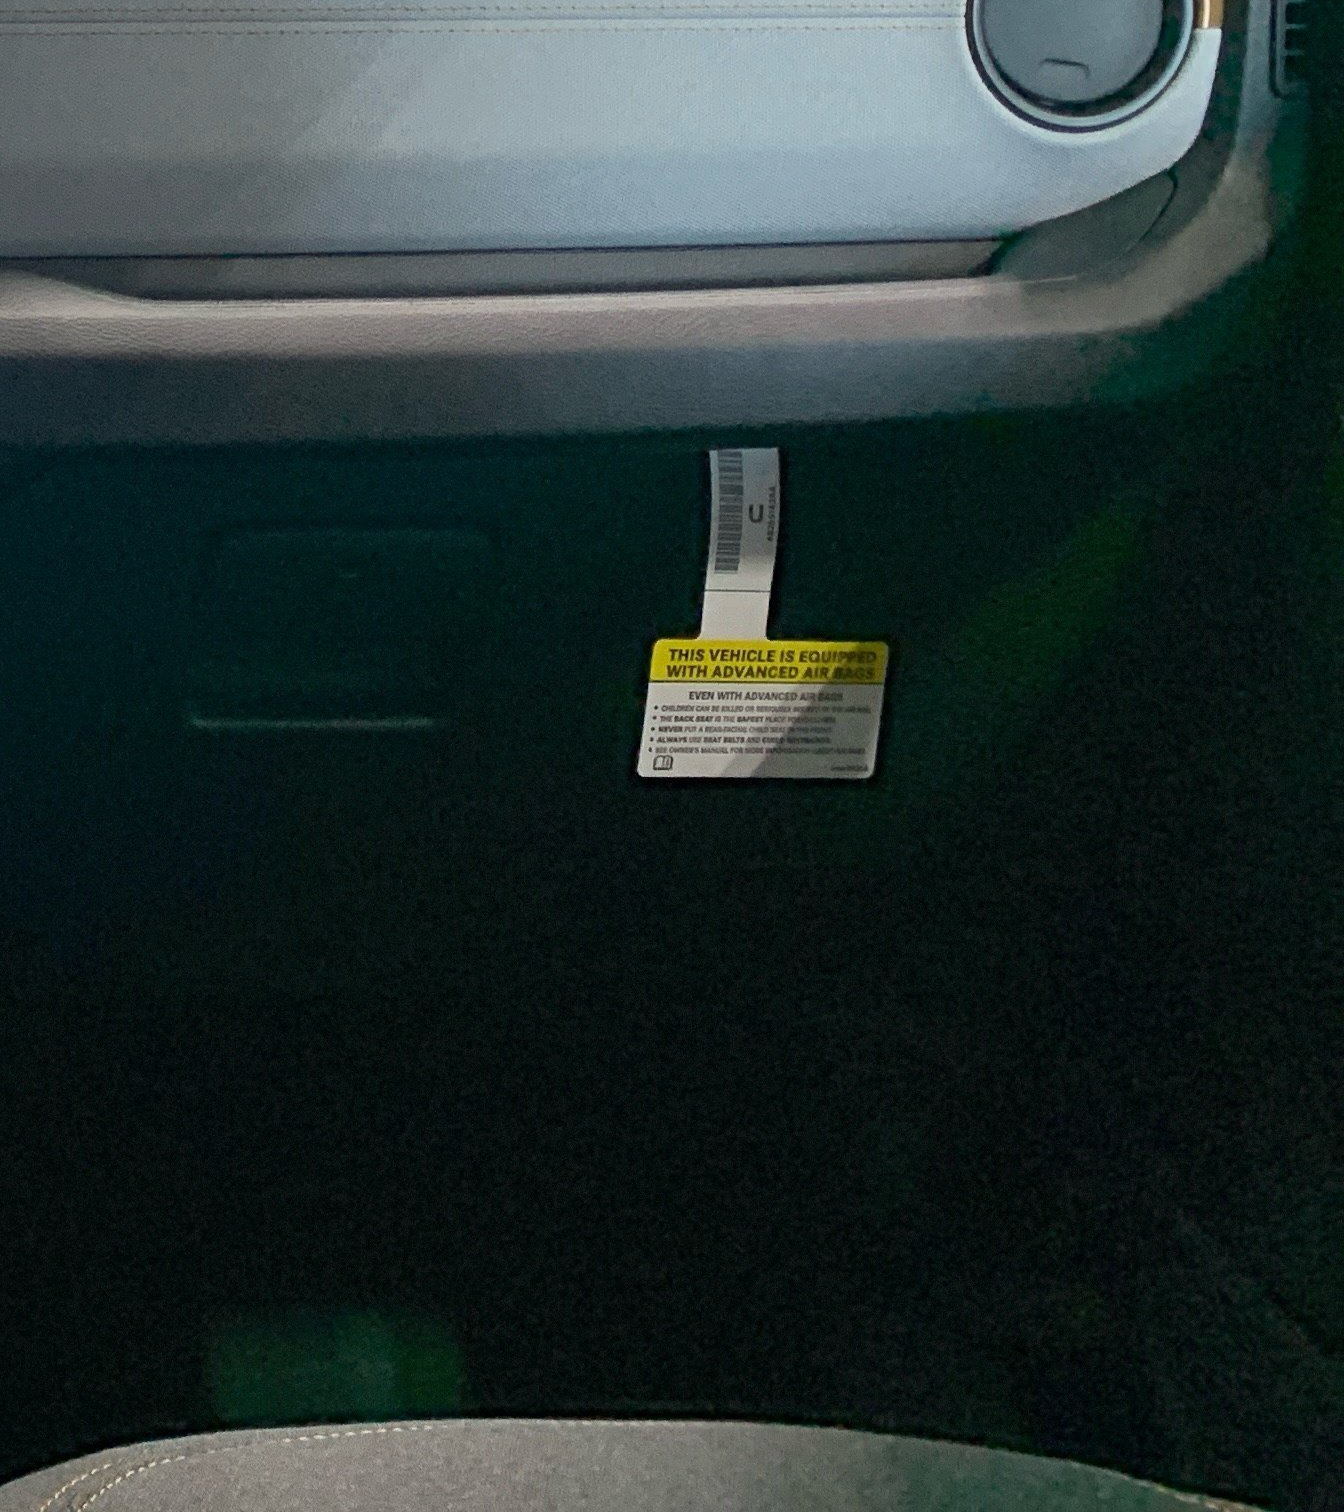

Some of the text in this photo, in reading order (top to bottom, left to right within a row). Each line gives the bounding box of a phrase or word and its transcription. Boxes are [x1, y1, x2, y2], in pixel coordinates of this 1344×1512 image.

[668, 648, 877, 664] THIS VEHICLE IS EQUIPPED
[666, 664, 875, 681] WITH ADVANCED AIR BAGS
[688, 691, 715, 701] EVEN
[716, 691, 743, 701] WITH
[744, 691, 798, 702] ADVANCED
[799, 691, 817, 702] AIR
[673, 715, 694, 723] BACK
[656, 736, 688, 744] ALWAYS
